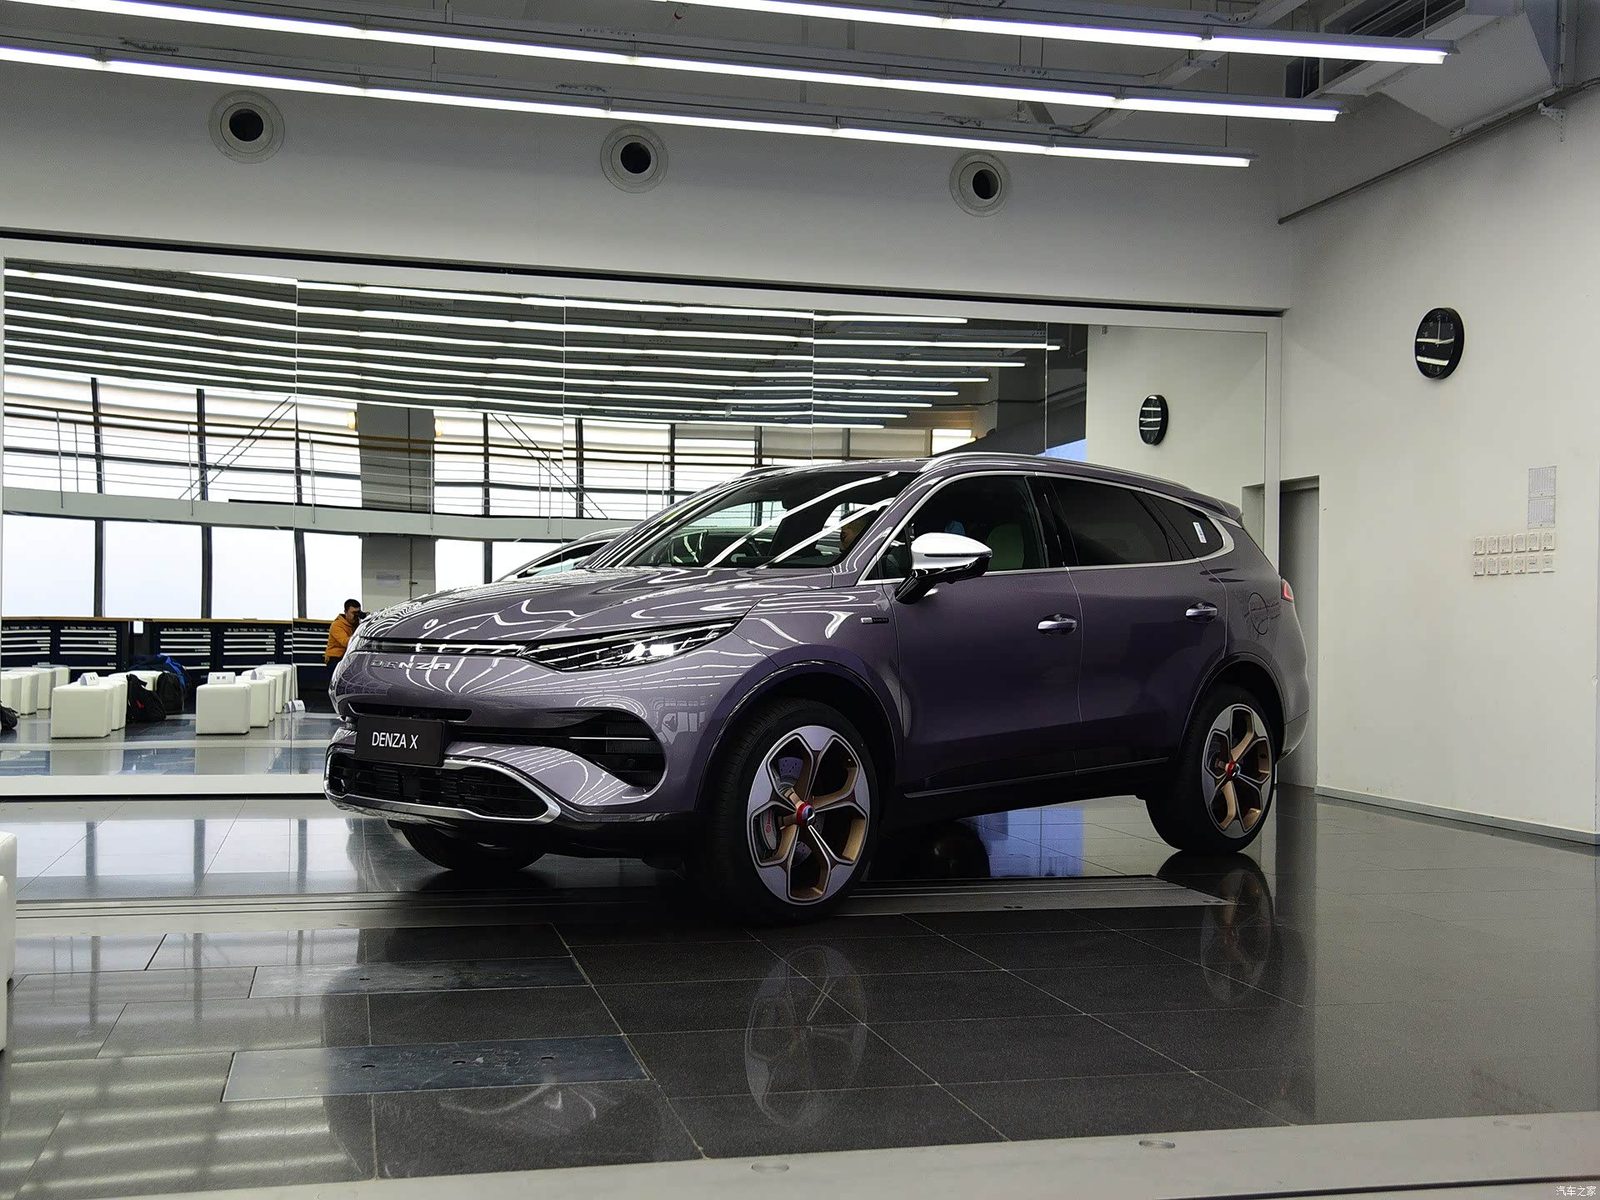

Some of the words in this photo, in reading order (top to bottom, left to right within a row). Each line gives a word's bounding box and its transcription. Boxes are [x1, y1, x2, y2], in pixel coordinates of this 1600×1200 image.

[370, 661, 452, 670] DENZA
[371, 731, 407, 749] DENZA
[409, 734, 419, 750] X
